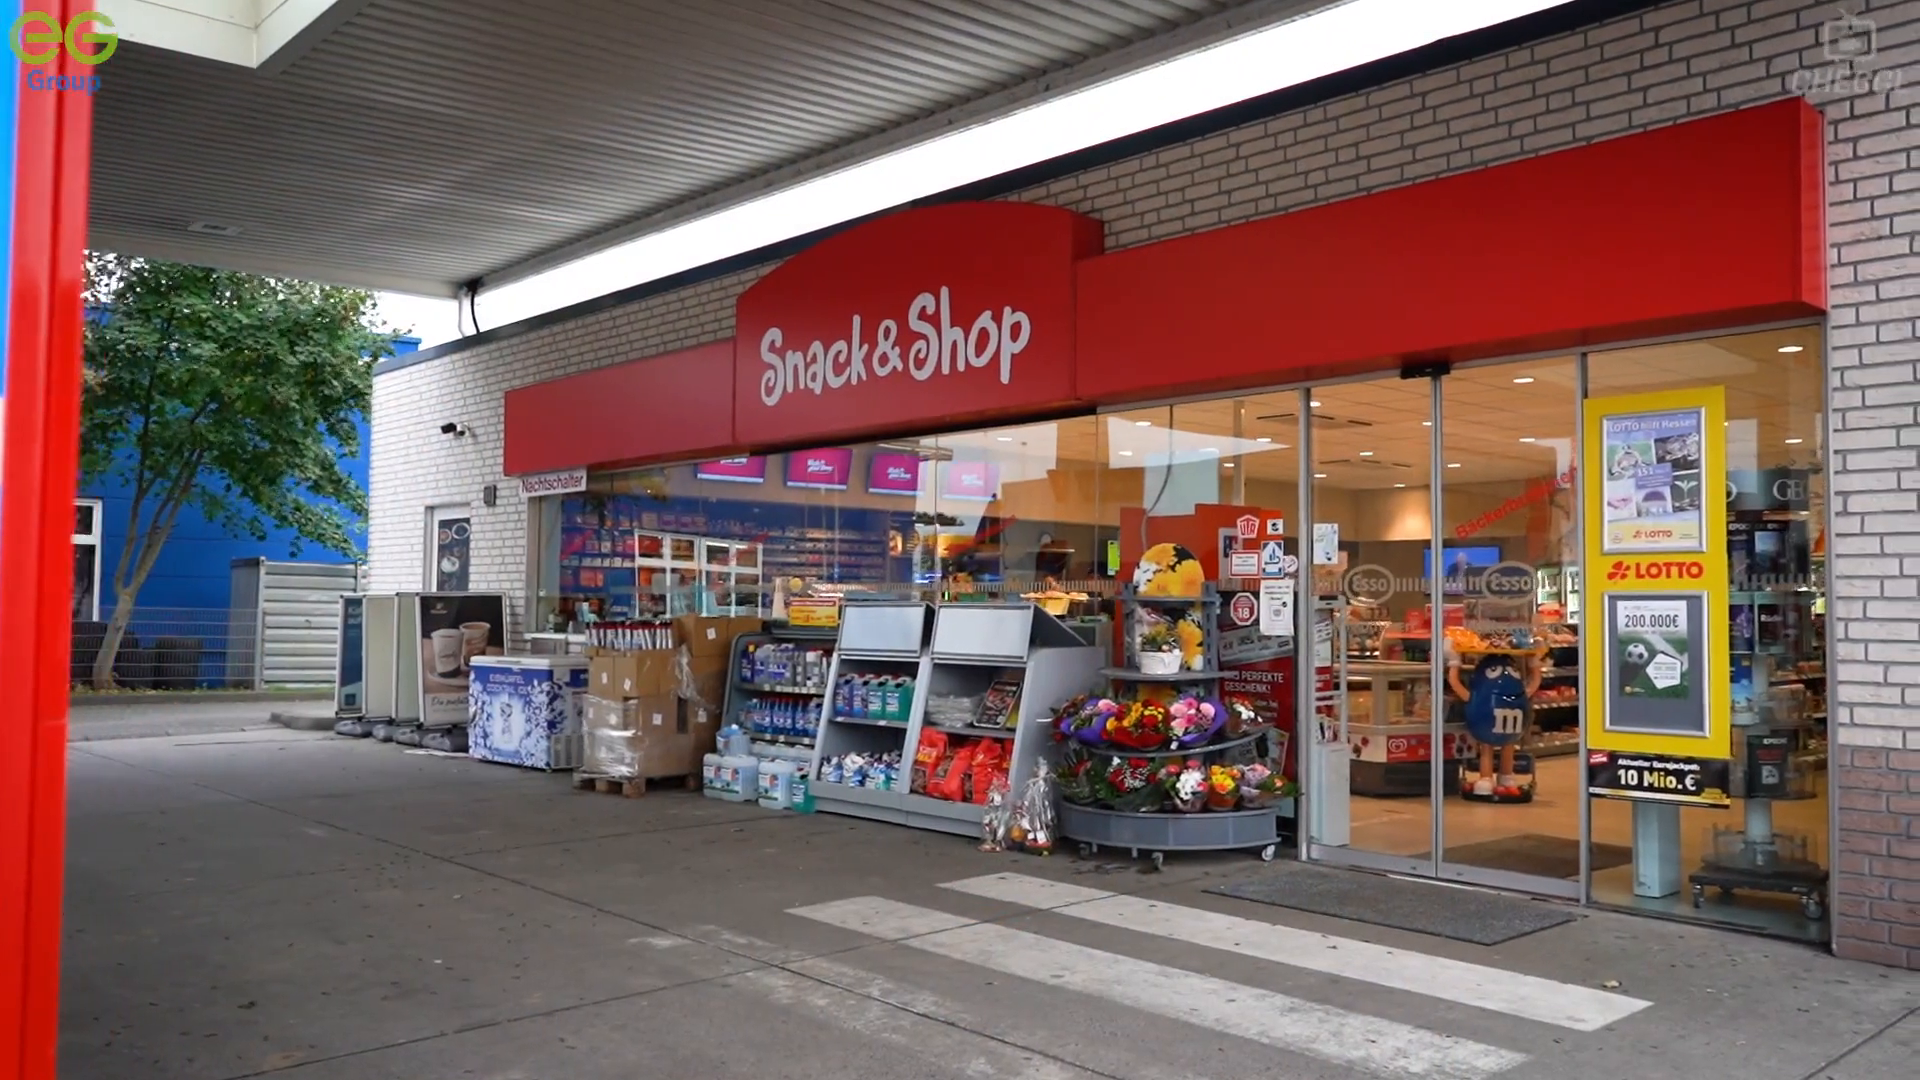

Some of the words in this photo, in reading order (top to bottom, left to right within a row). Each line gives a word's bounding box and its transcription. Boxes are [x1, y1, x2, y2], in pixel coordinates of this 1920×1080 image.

[761, 314, 869, 406] Snack
[872, 319, 903, 377] &
[908, 285, 1031, 384] Shop
[1609, 421, 1639, 432] LOTTO
[521, 473, 584, 493] Nachtschalter
[1644, 530, 1673, 539] LOTTO
[1635, 561, 1704, 579] LOTTO
[1237, 607, 1250, 619] 18
[1624, 613, 1680, 628] 200.000€
[1241, 670, 1285, 683] PERFEKTE
[1492, 708, 1524, 734] m
[1616, 768, 1639, 786] 10
[1642, 770, 1684, 789] Mio.
